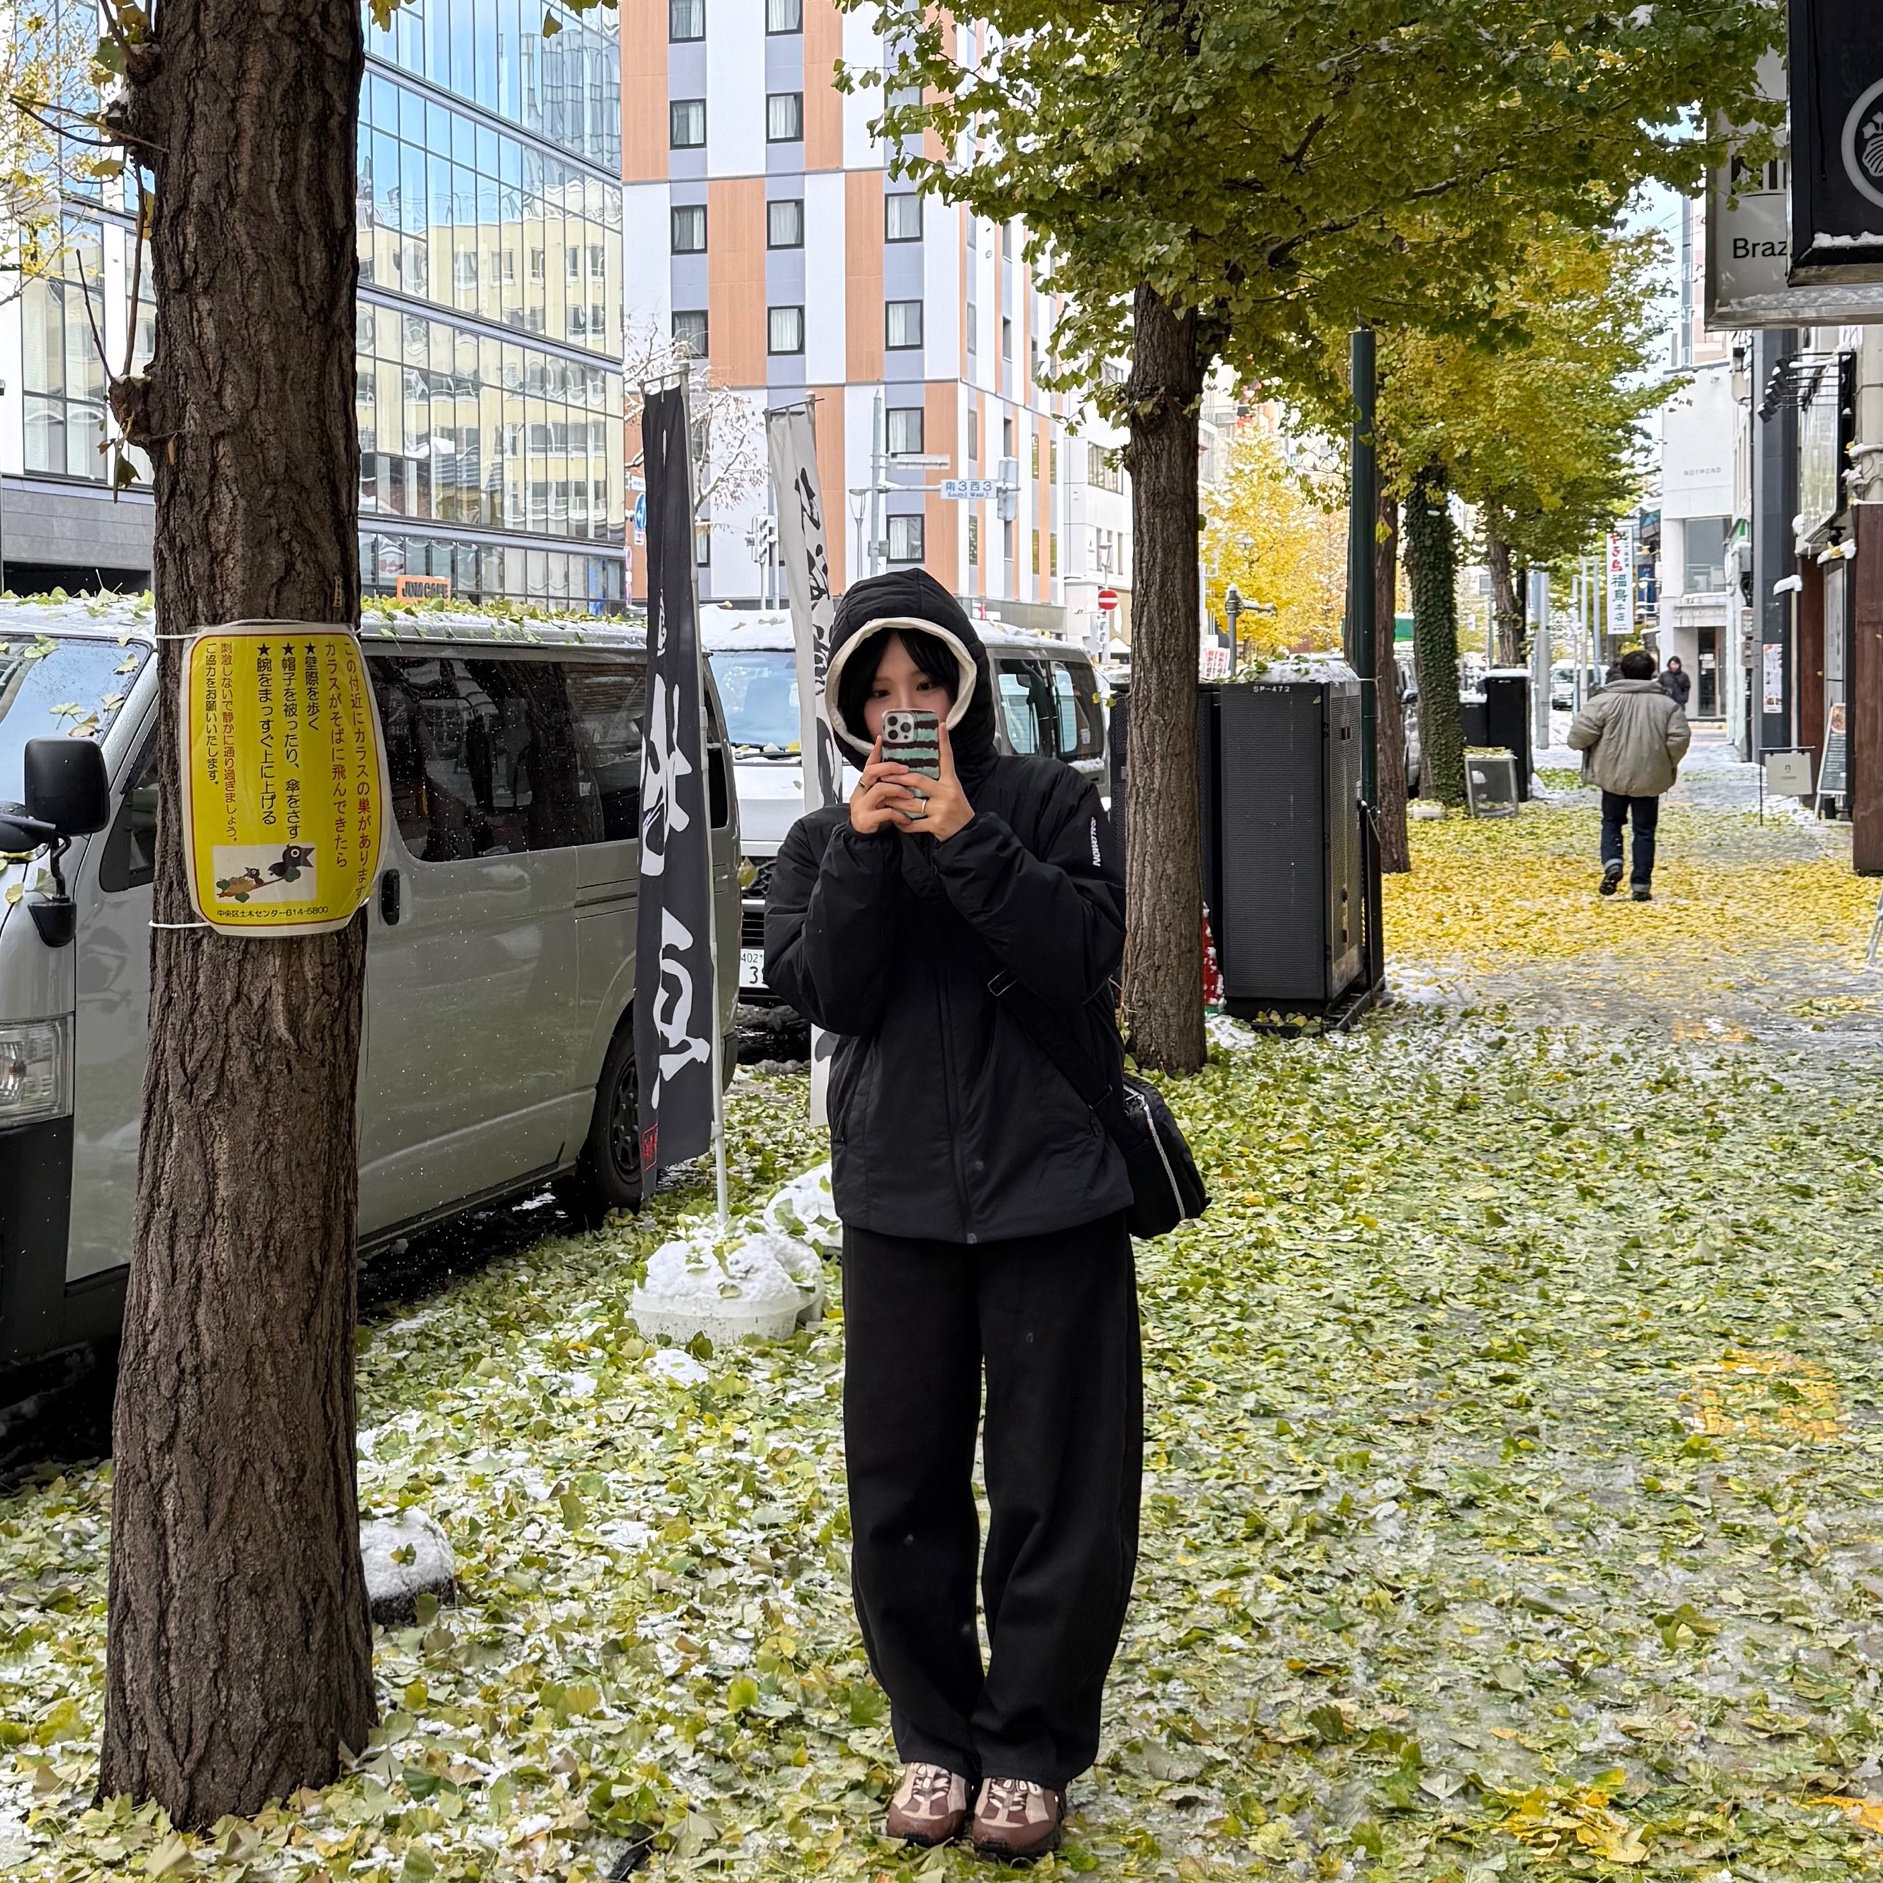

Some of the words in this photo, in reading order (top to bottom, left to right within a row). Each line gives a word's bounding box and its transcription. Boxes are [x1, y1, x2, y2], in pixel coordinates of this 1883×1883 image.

[946, 480, 992, 492] 南3西3
[256, 658, 277, 825] 腕をまっすぐ上に上げる
[304, 656, 320, 731] 壁際を歩く
[1252, 685, 1291, 693] SP-472
[325, 641, 347, 868] カラスがそばに飛んできたら
[344, 642, 372, 900] この付近にカラスの巣があります
